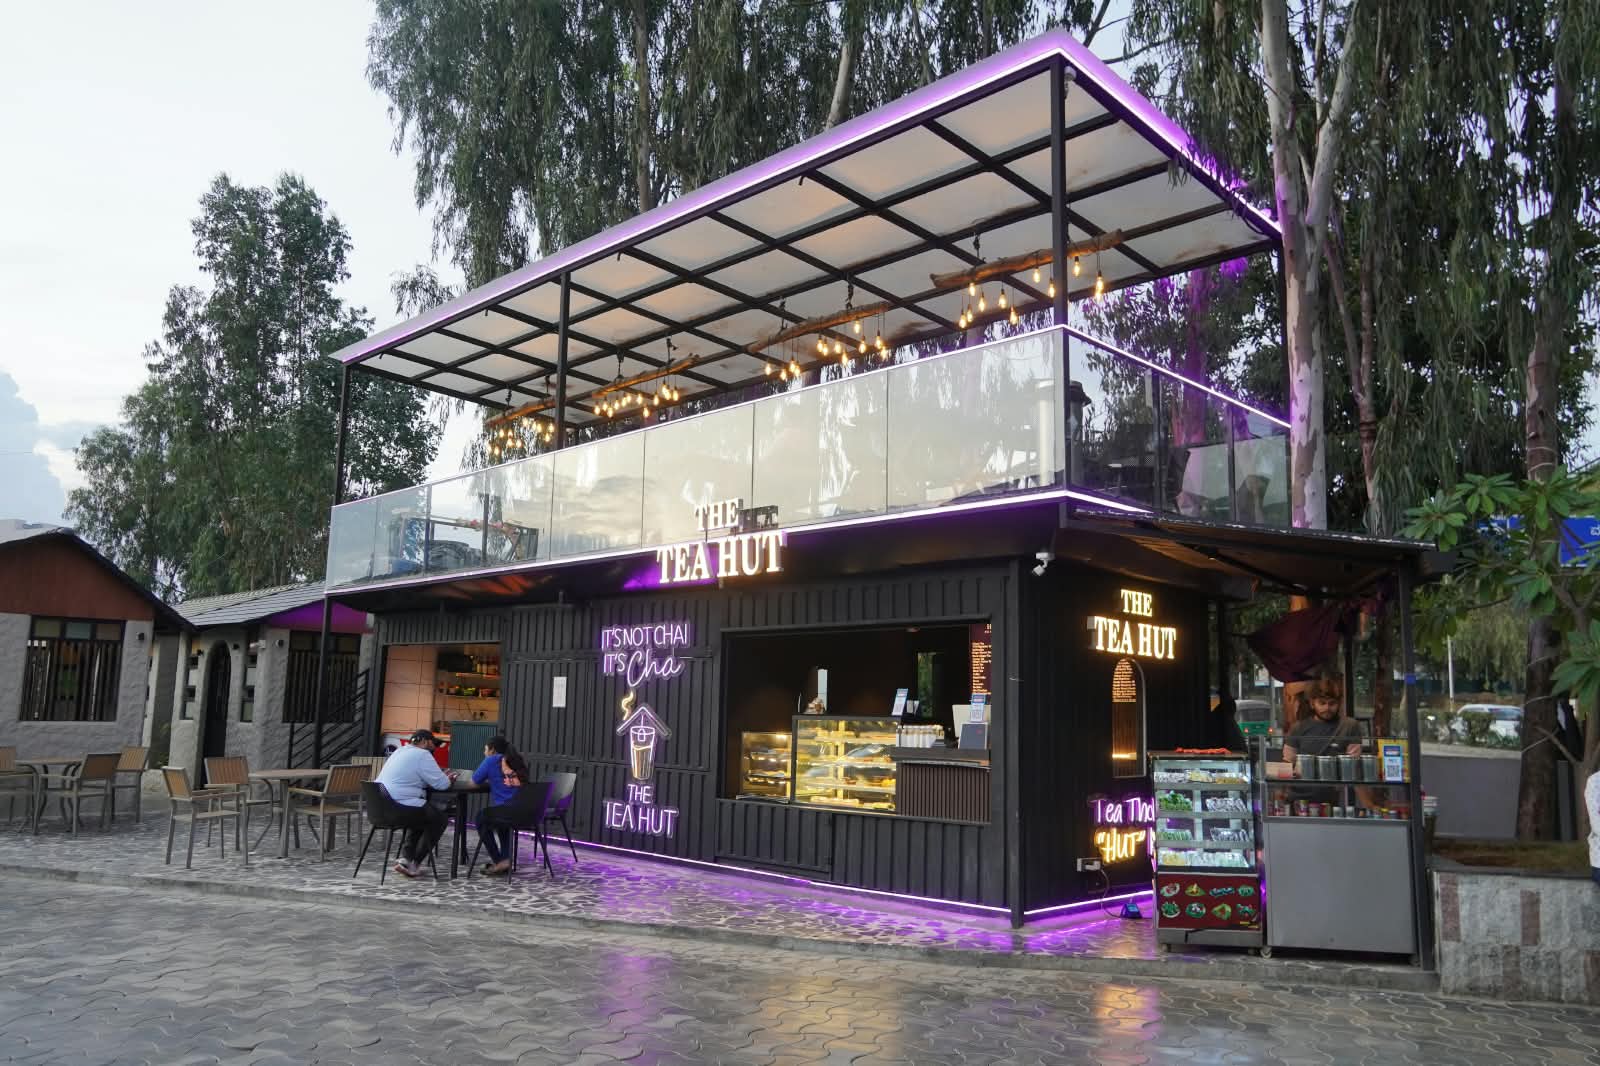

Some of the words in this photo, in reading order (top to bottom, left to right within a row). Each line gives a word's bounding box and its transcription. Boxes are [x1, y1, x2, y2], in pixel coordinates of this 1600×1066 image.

[694, 498, 740, 531] THE
[656, 540, 712, 584] TEA
[717, 531, 784, 578] HUT
[1120, 588, 1153, 617] THE
[601, 627, 622, 651] IT'S
[623, 626, 654, 647] NOT
[654, 622, 687, 646] CHAI
[1094, 615, 1134, 655] TEA
[1137, 622, 1177, 660] HUT
[603, 653, 627, 674] IT'S
[627, 648, 682, 688] Cha
[626, 783, 653, 804] THE
[638, 807, 679, 837] HUT
[1090, 798, 1123, 823] Tea
